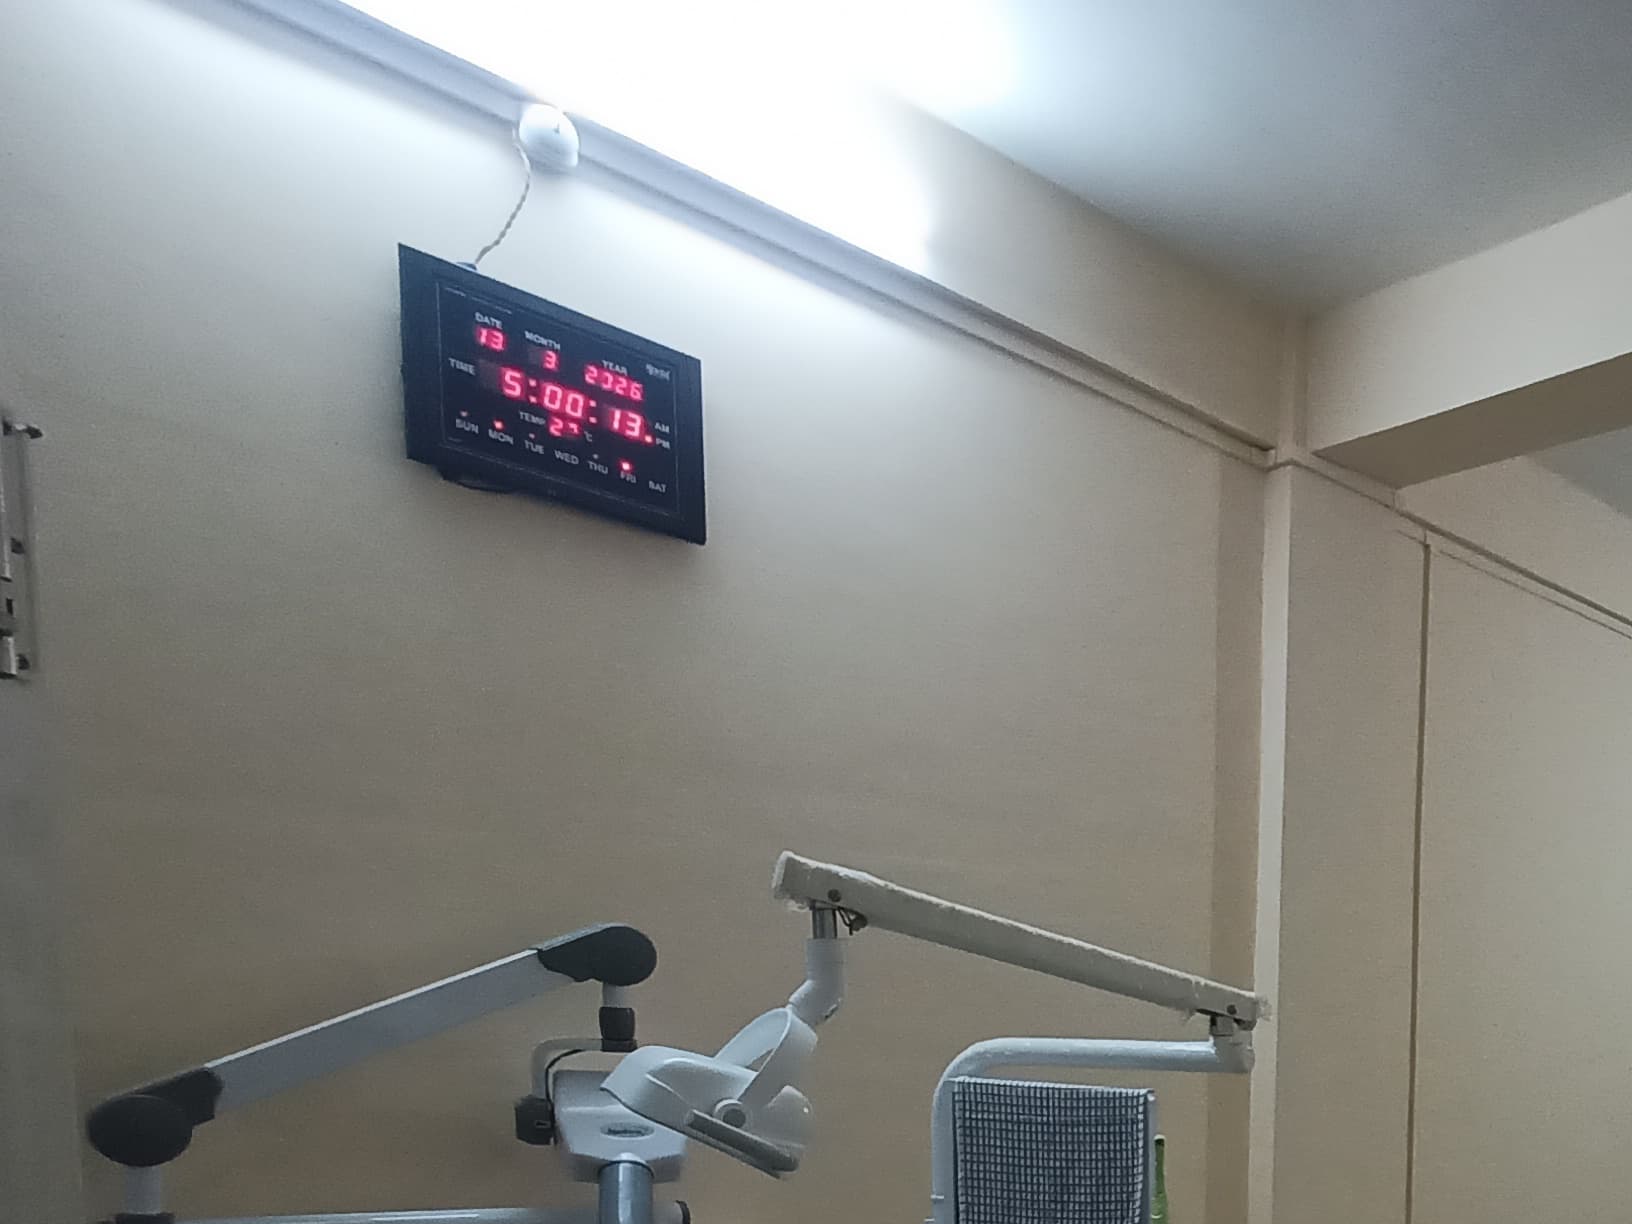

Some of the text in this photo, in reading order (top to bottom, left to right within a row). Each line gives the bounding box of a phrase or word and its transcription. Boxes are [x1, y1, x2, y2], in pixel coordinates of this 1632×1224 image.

[475, 311, 503, 330] DATE
[525, 330, 561, 351] MONTH
[601, 359, 629, 377] YEAR
[479, 328, 506, 351] 13
[448, 356, 477, 376] TIME
[543, 350, 559, 370] 3
[519, 411, 546, 426] TEMP
[654, 421, 670, 434] AM
[655, 437, 671, 450] PM
[487, 428, 515, 446] MON
[523, 439, 545, 455] TUE
[553, 449, 580, 466] WED
[588, 460, 609, 475] THU
[620, 471, 637, 485] FRI
